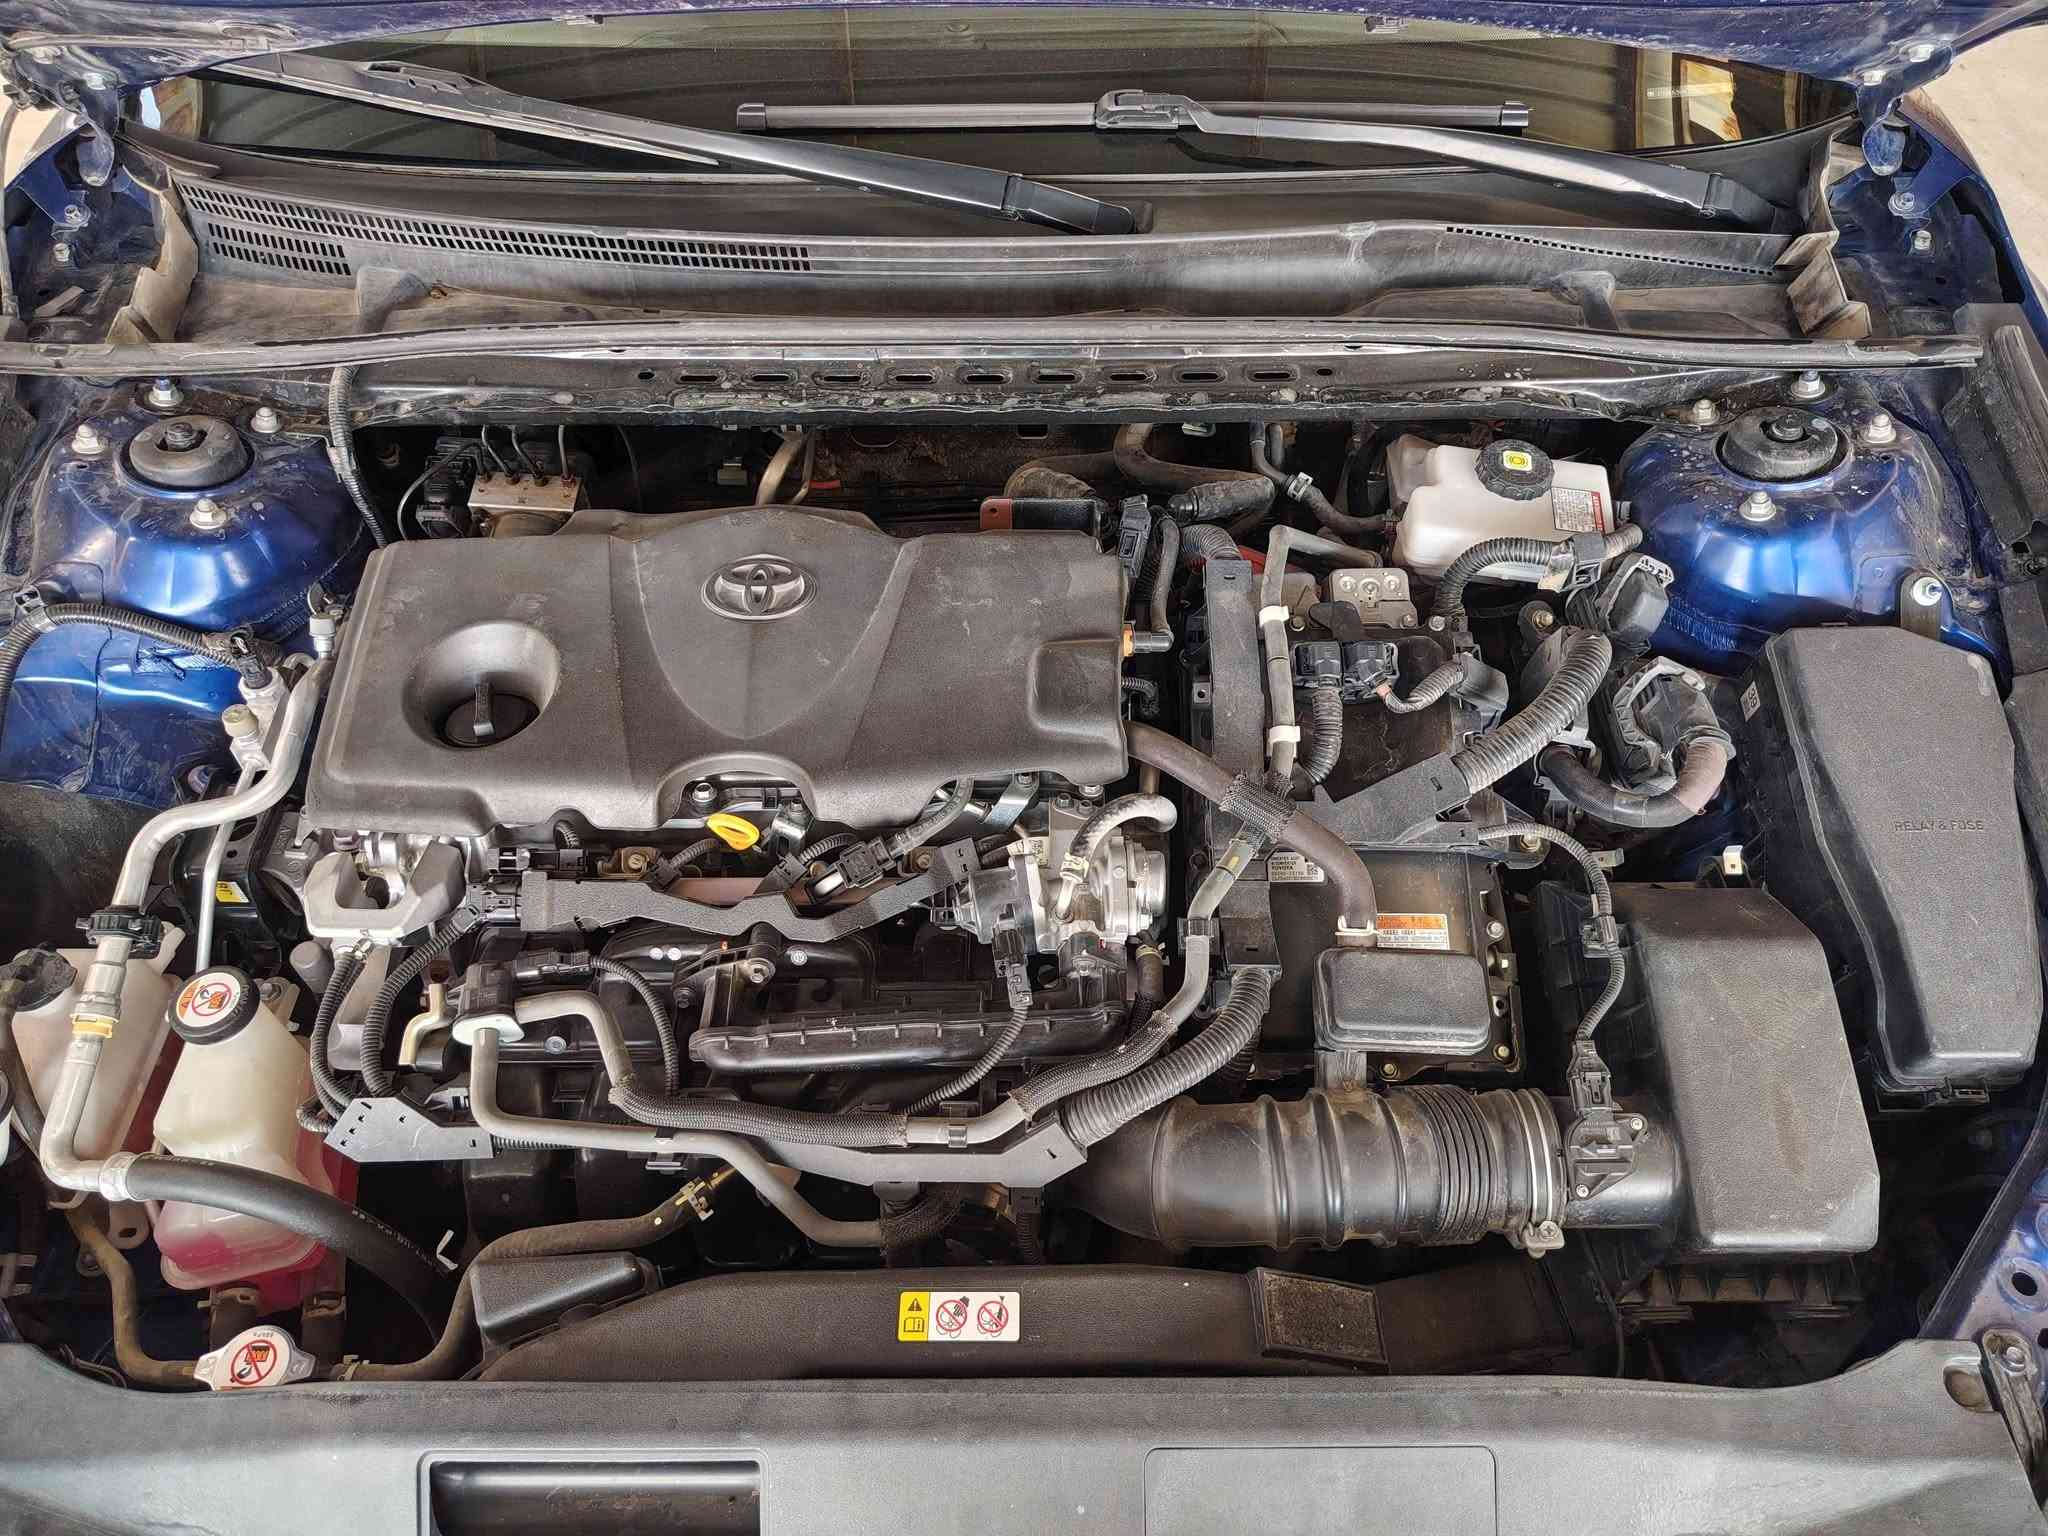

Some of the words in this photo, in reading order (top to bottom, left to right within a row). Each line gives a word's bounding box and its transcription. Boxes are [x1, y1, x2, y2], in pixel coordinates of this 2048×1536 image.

[1894, 820, 1934, 832] RELAY
[1938, 820, 1948, 832] &
[1951, 820, 1984, 831] FUSE
